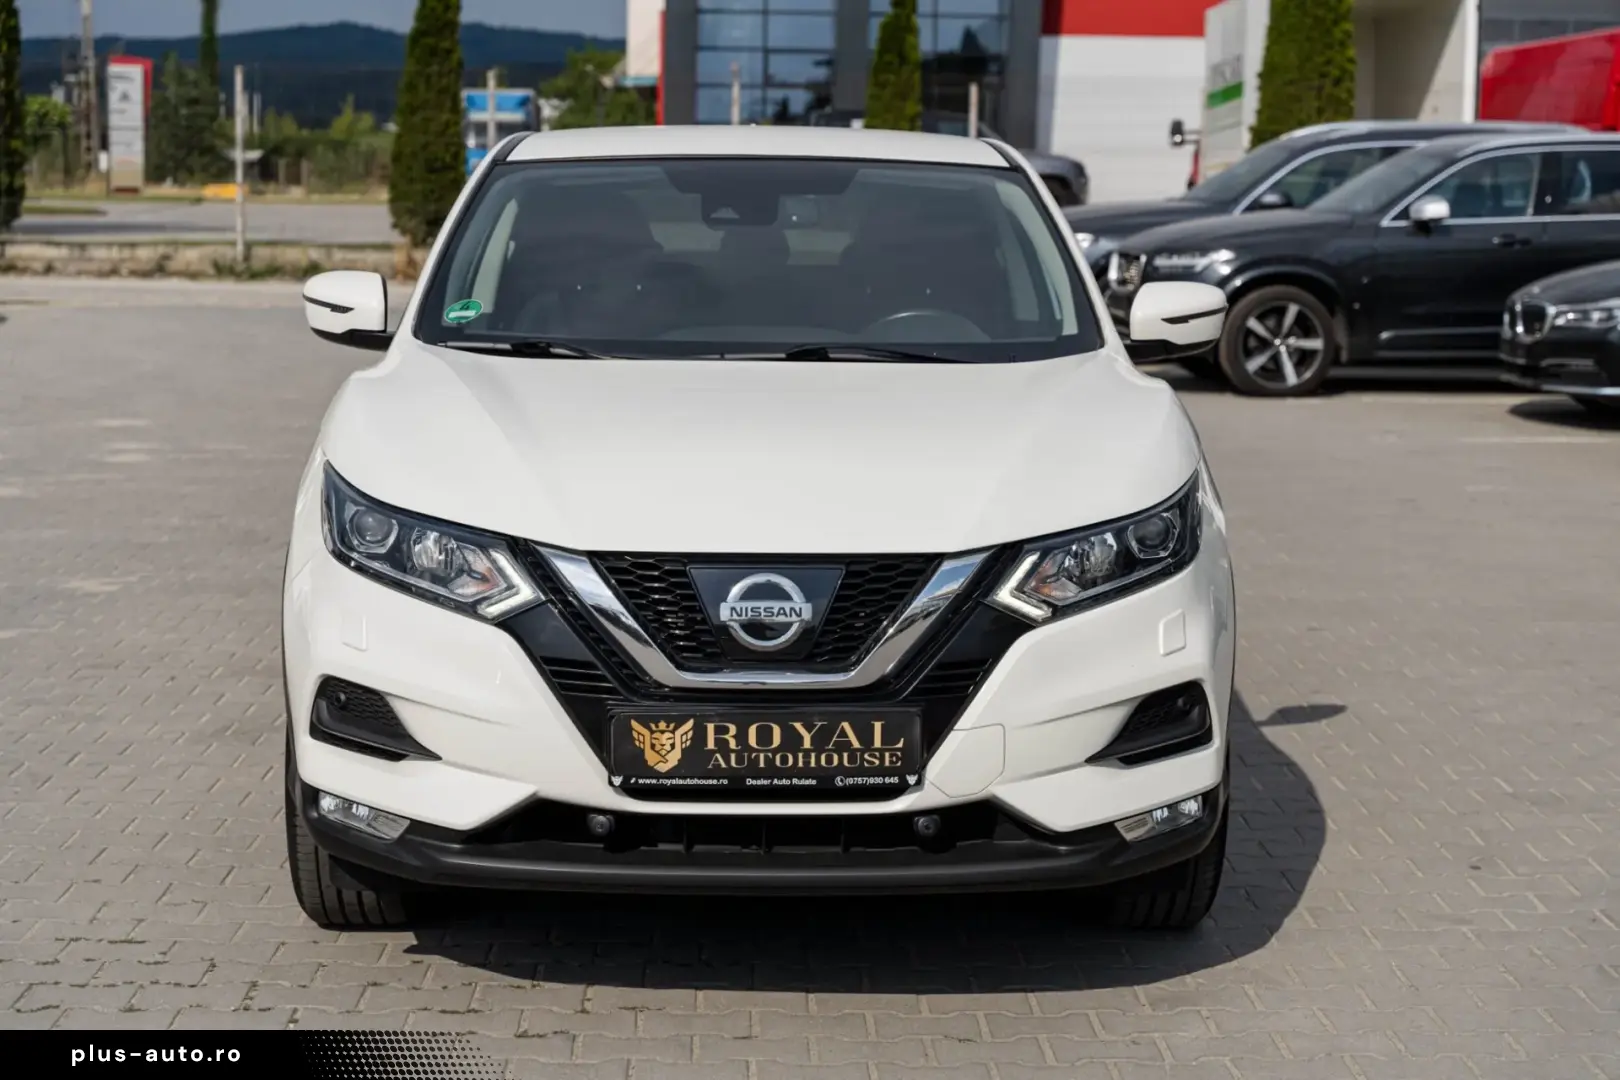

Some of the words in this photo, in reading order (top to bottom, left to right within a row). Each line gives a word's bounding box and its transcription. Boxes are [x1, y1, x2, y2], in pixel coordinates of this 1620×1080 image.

[730, 606, 802, 618] NISSAN
[703, 721, 904, 750] ROYAL
[707, 751, 903, 769] AUTOHOUSE
[637, 777, 728, 786] www.royalautohouse.ro
[745, 778, 771, 786] Dealer
[772, 778, 791, 786] Auto
[791, 778, 817, 786] Rulate
[884, 776, 899, 785] 645
